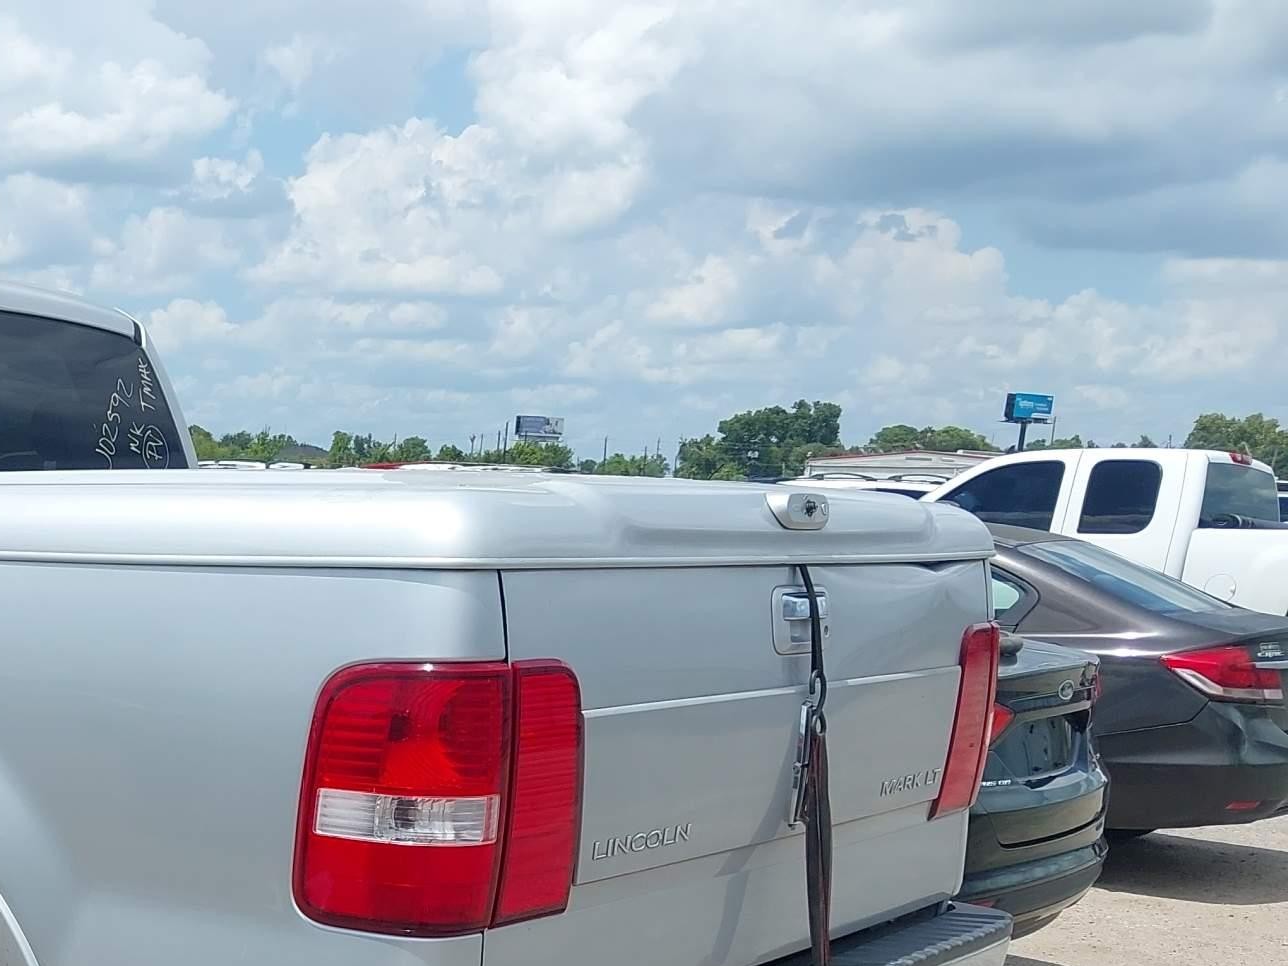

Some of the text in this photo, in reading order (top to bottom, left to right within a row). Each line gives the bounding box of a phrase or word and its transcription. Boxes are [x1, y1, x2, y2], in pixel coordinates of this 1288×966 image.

[880, 768, 941, 797] MARK LT
[592, 823, 692, 860] LINCOLN
